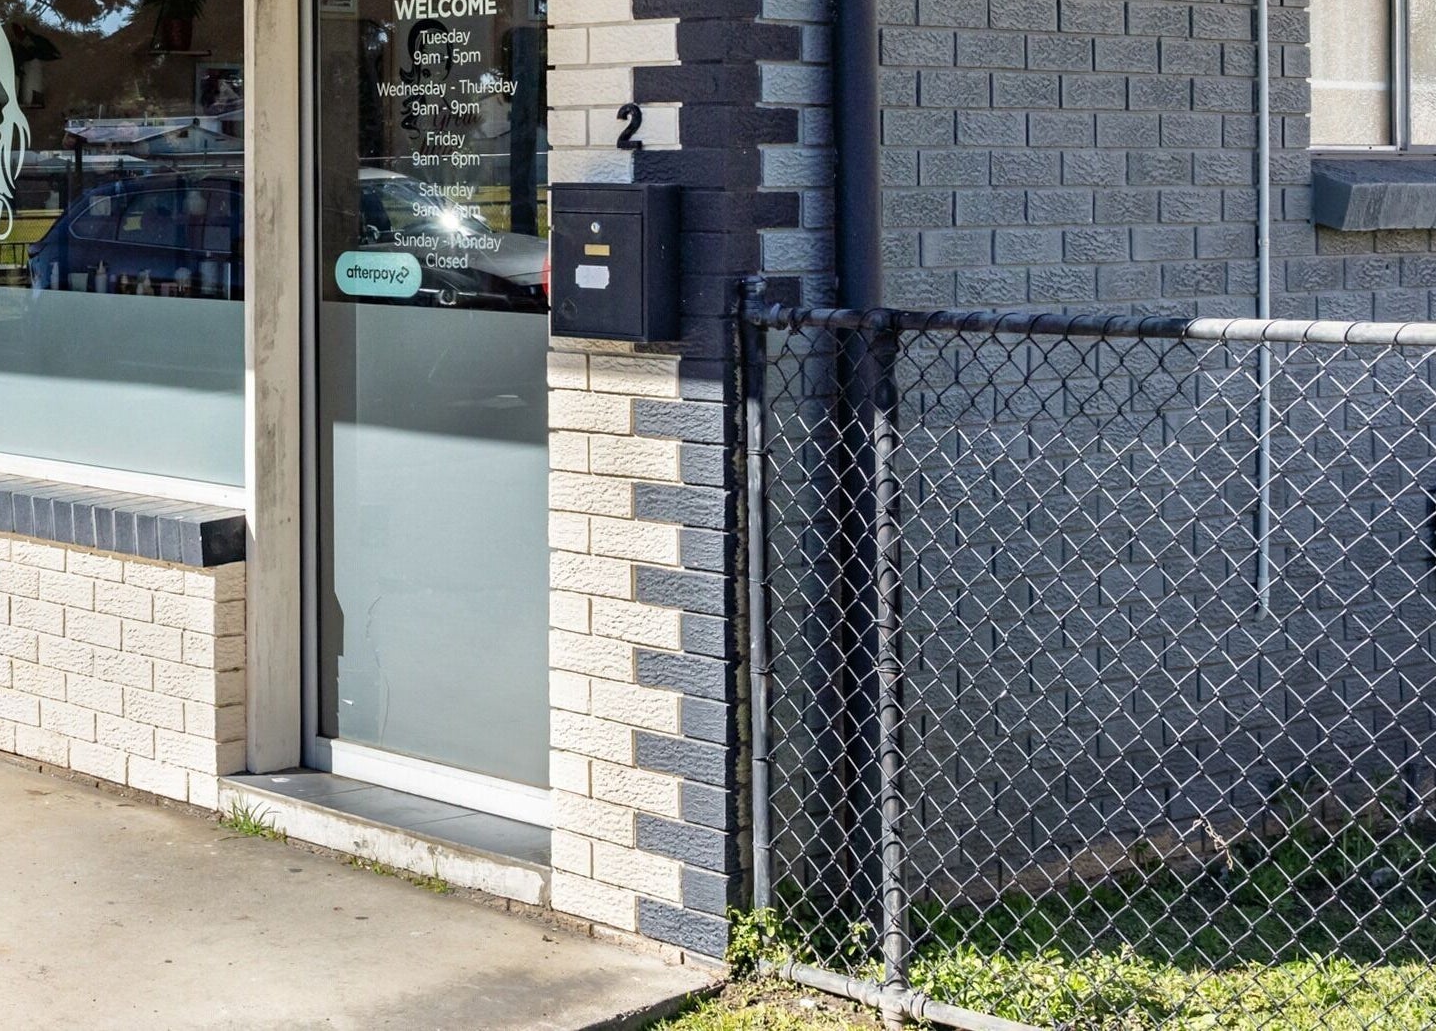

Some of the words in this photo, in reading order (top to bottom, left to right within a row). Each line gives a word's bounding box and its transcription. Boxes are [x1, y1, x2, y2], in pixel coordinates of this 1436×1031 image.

[419, 28, 471, 45] Tuesday
[413, 50, 441, 66] 9am
[452, 48, 481, 66] 5pm
[376, 80, 447, 98] Wednesday
[459, 77, 519, 96] Thursday
[411, 100, 439, 116] 9am
[450, 99, 480, 117] 9pm
[616, 103, 643, 150] 2
[426, 130, 465, 149] Friday
[412, 151, 440, 167] 9am
[451, 151, 480, 168] 6pm
[418, 181, 475, 200] Saturday
[393, 232, 440, 250] Sunday
[449, 233, 502, 252] Monday
[425, 252, 469, 269] Closed
[346, 265, 395, 283] afterpay
